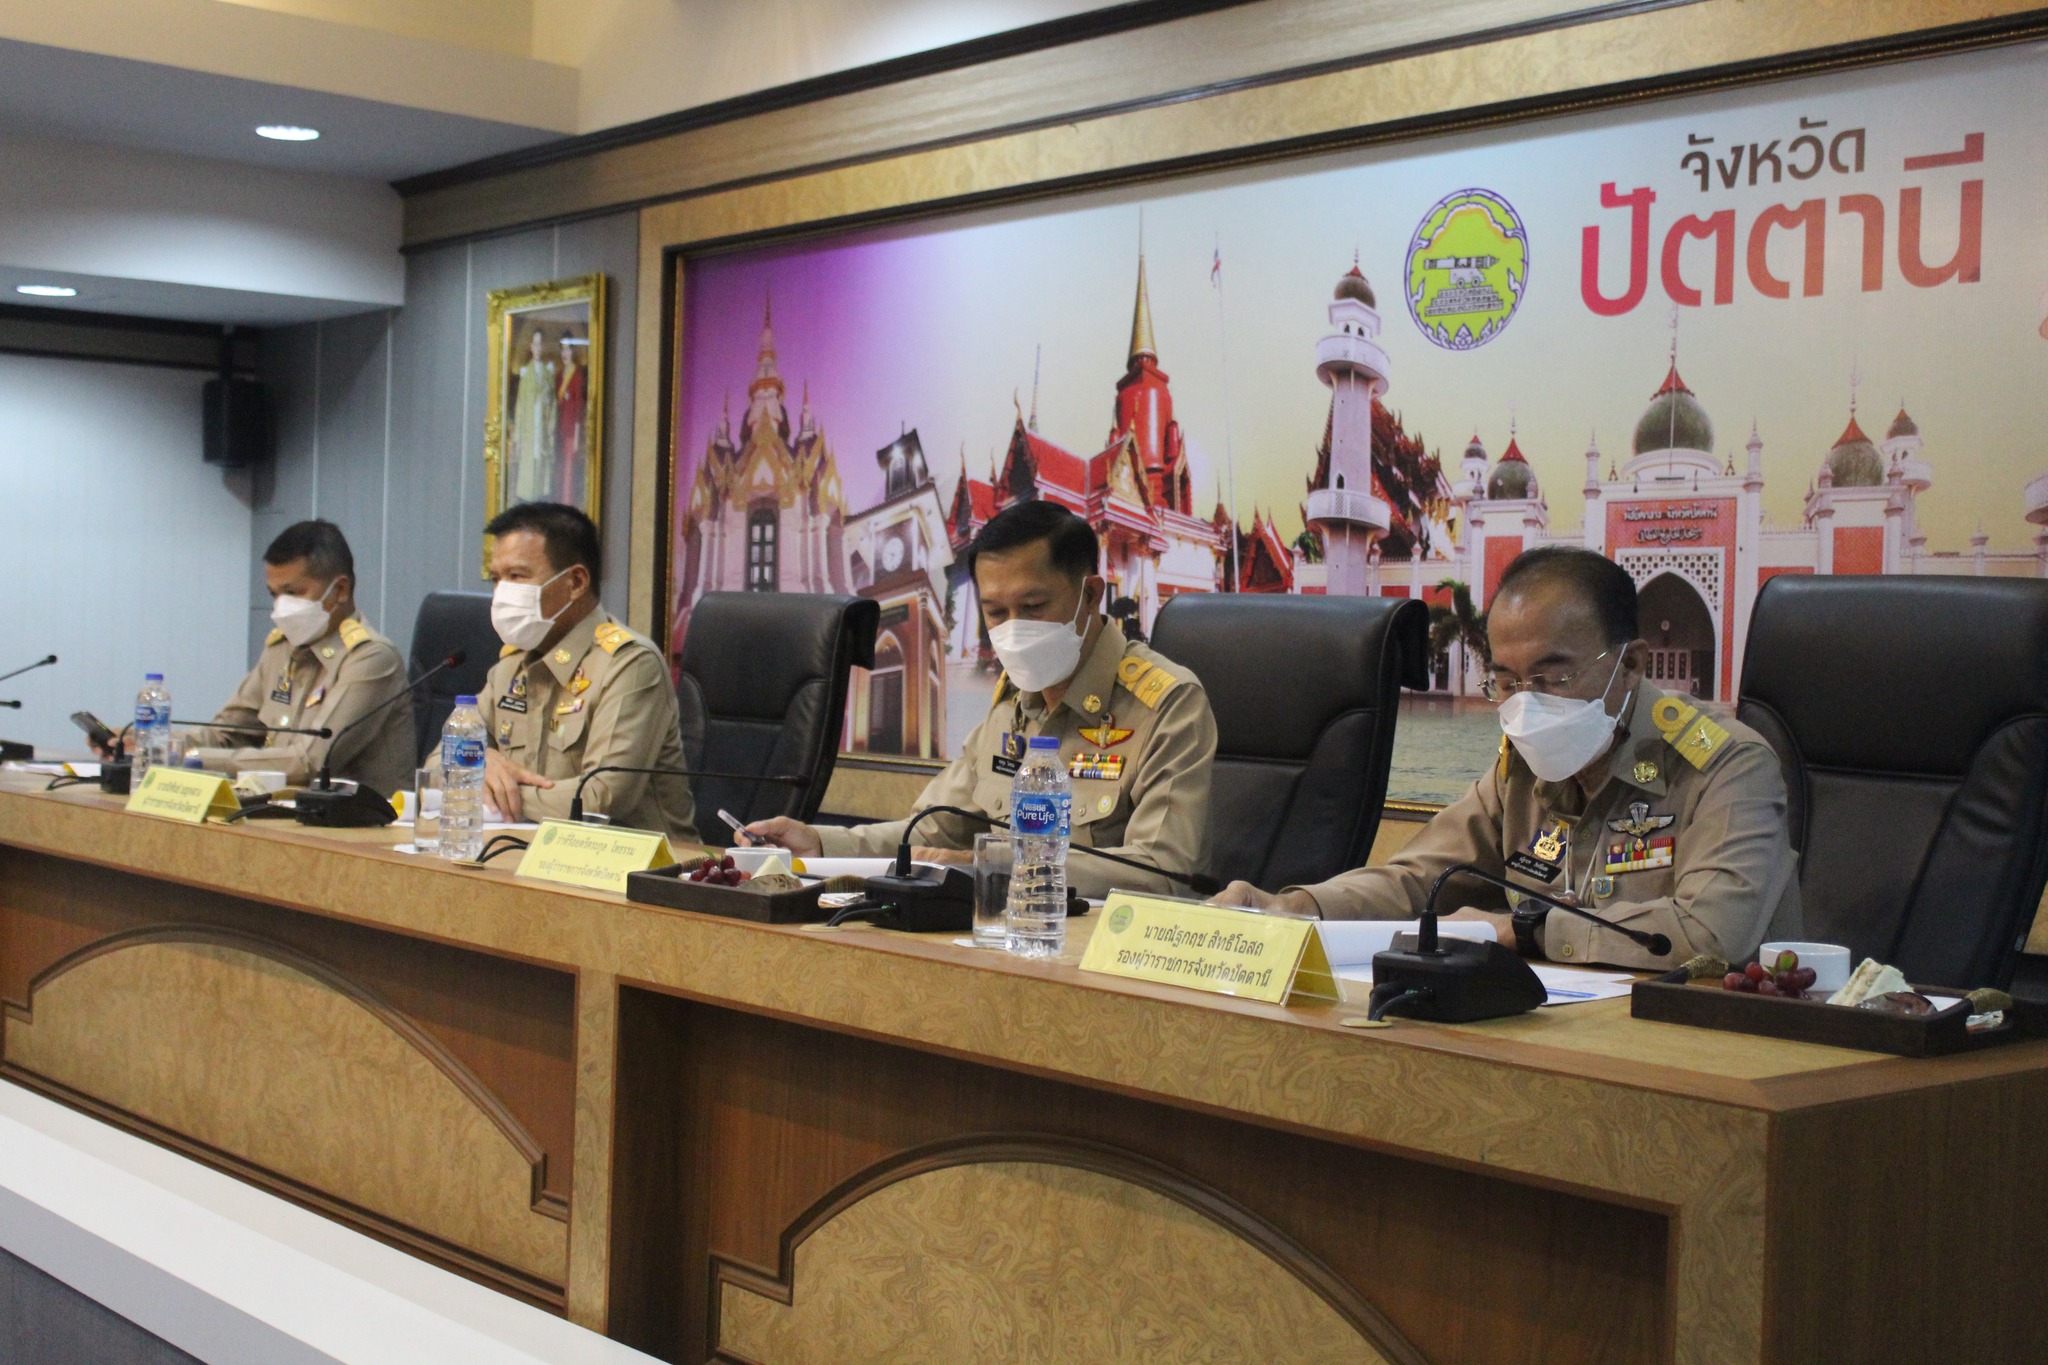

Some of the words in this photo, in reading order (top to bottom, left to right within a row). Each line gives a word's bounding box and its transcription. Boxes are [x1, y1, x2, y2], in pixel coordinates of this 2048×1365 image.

[1680, 117, 1866, 192] จังหวัด
[1580, 132, 1985, 317] ปัตตานี
[1017, 810, 1037, 821] Pure
[1038, 812, 1055, 824] Life
[1117, 947, 1273, 988] รองผู้ว่าราชการจังหวัดปัตตานี
